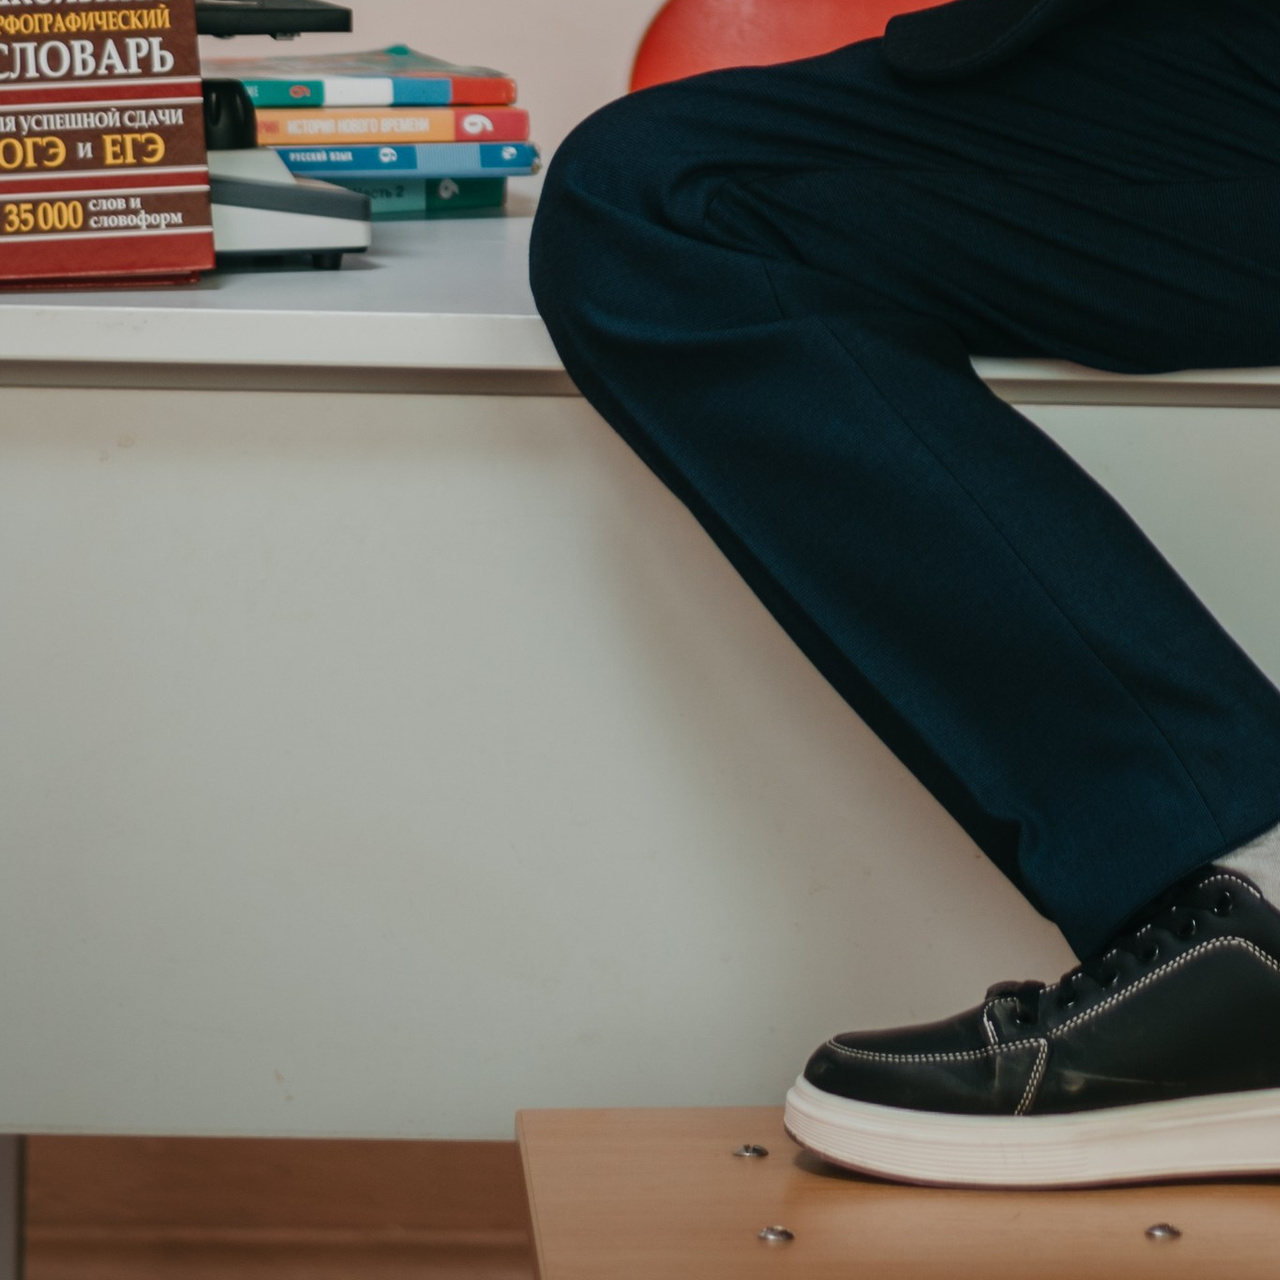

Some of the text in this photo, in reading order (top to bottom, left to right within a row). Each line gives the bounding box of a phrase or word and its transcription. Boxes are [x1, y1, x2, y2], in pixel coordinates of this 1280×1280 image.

[18, 108, 120, 135] УСПЕШНОЙ
[123, 109, 184, 128] СДАЧИ
[0, 136, 66, 169] ОГЭ
[102, 132, 166, 165] ЕГЭ
[289, 149, 328, 162] РУССКИЙ
[88, 198, 126, 211] слов
[129, 197, 142, 209] и
[89, 210, 183, 229] словоформ
